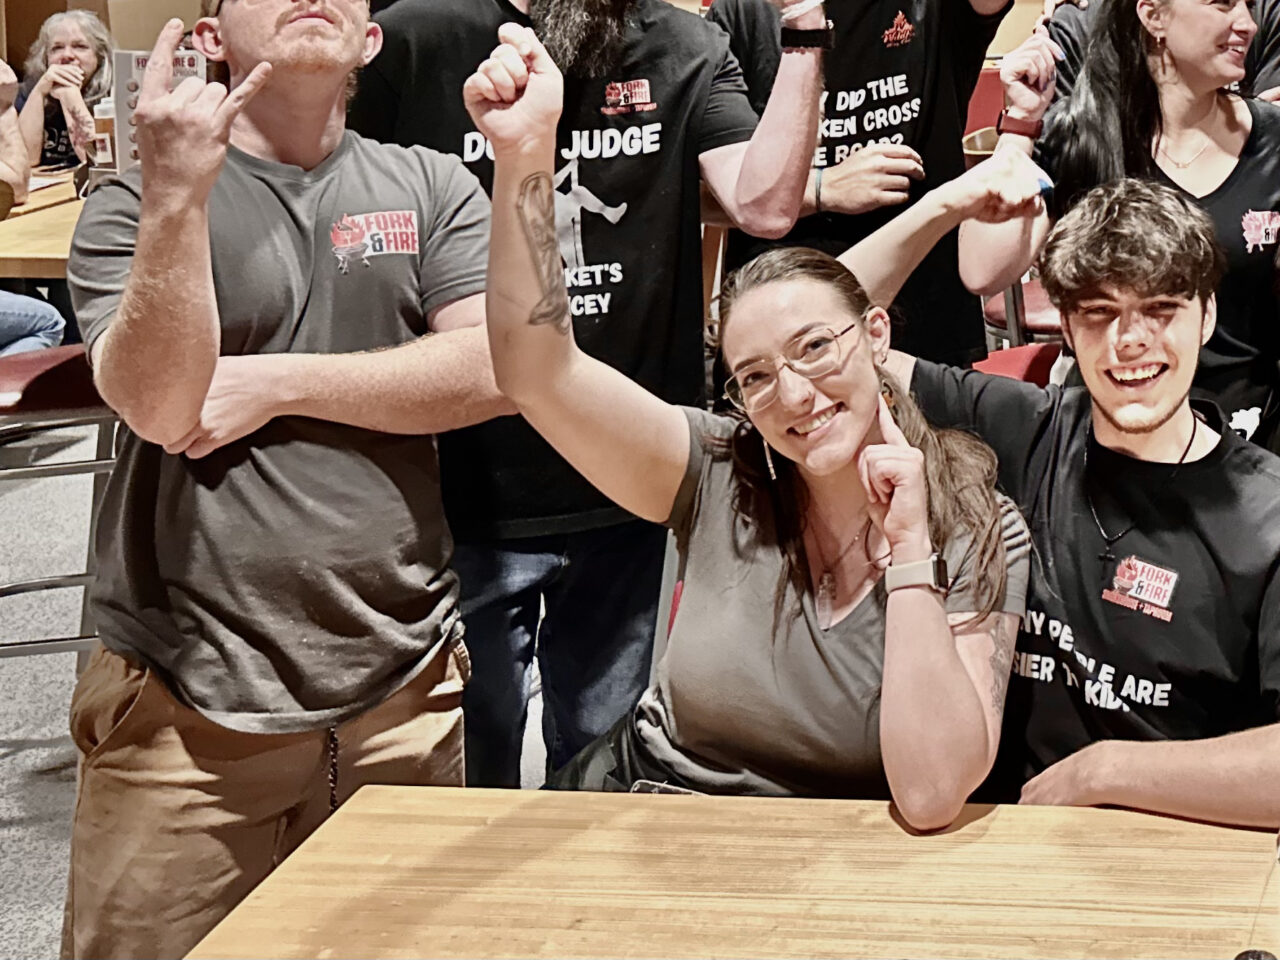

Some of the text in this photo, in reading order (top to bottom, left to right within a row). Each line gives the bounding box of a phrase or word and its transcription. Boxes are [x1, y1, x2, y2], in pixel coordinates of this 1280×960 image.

[621, 80, 645, 93] FORK
[836, 88, 866, 111] DID
[867, 73, 909, 101] THE
[863, 97, 921, 132] CROSS
[560, 122, 663, 161] JUDGE
[363, 211, 415, 233] FORK
[370, 231, 418, 253] & FIRE
[1140, 564, 1173, 586] FORK
[1145, 583, 1169, 603] FIRE
[1120, 674, 1172, 708] ARE
